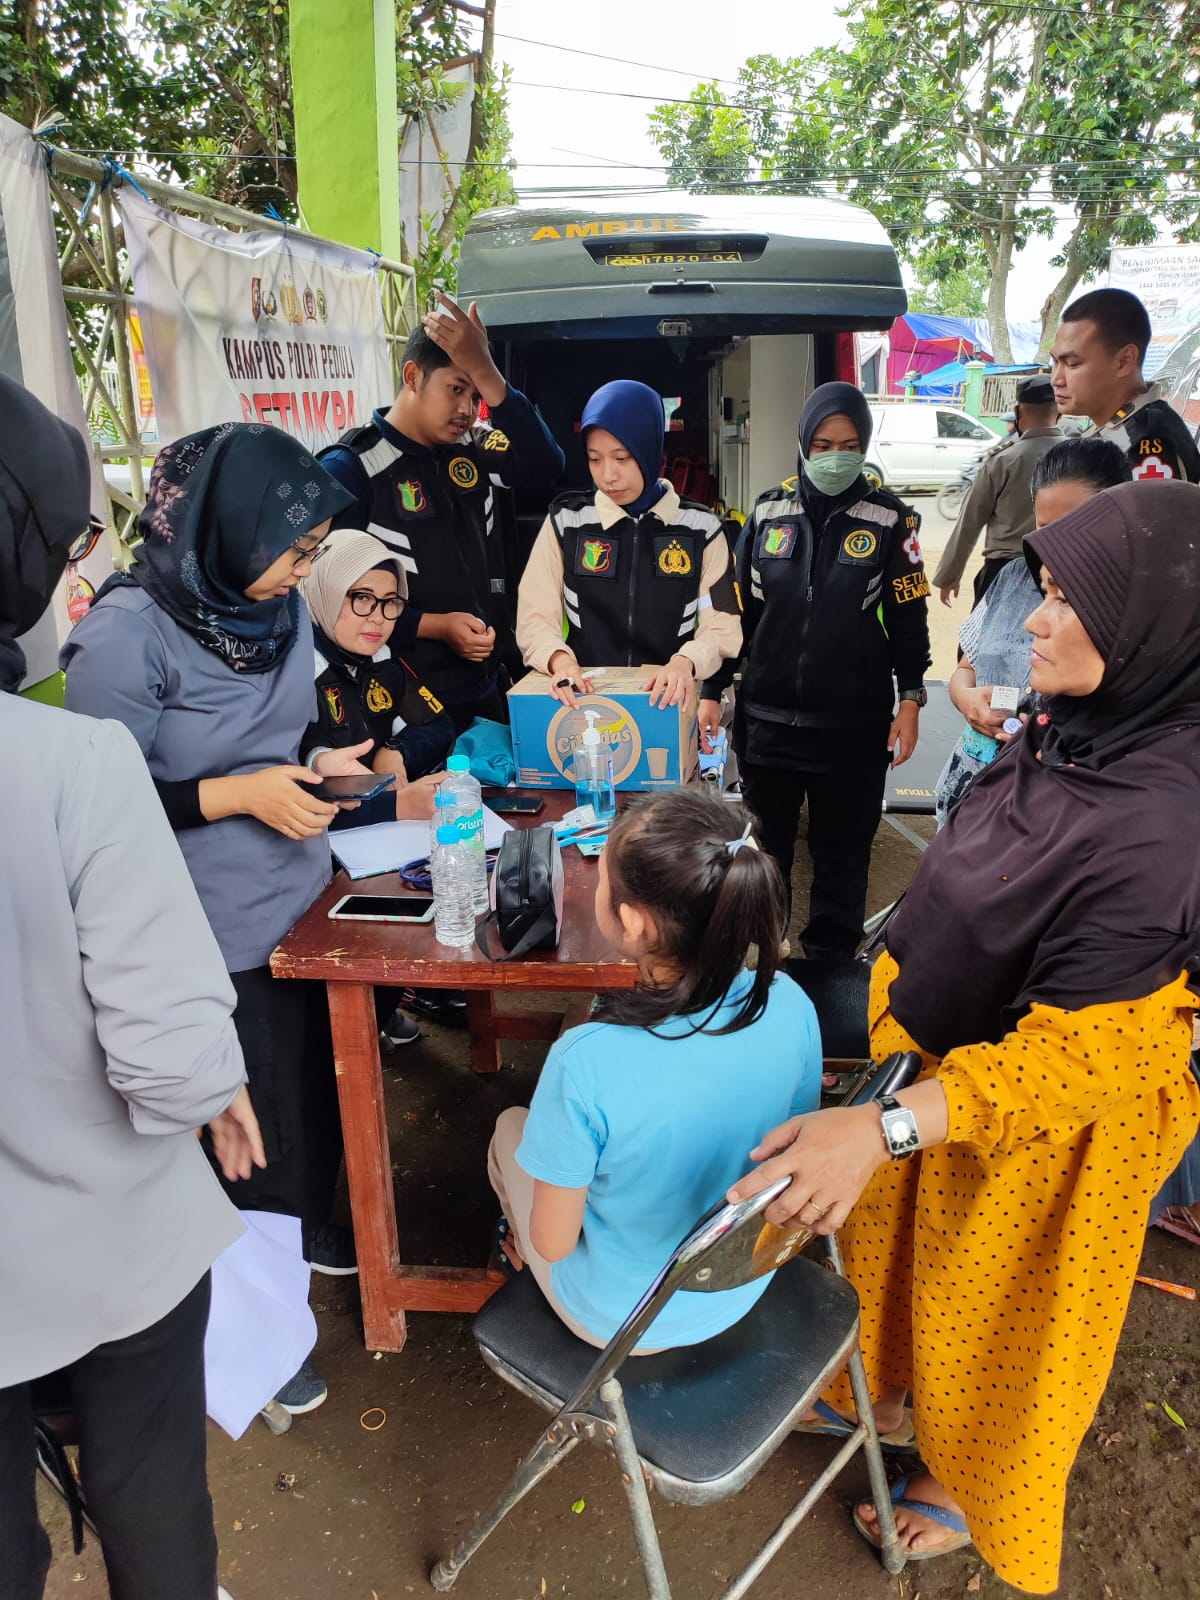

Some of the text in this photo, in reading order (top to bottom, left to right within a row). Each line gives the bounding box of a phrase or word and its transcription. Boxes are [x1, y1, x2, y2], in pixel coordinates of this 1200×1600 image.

[223, 338, 355, 380] KAMPUS POLRI PEDULI
[1139, 438, 1164, 455] RS
